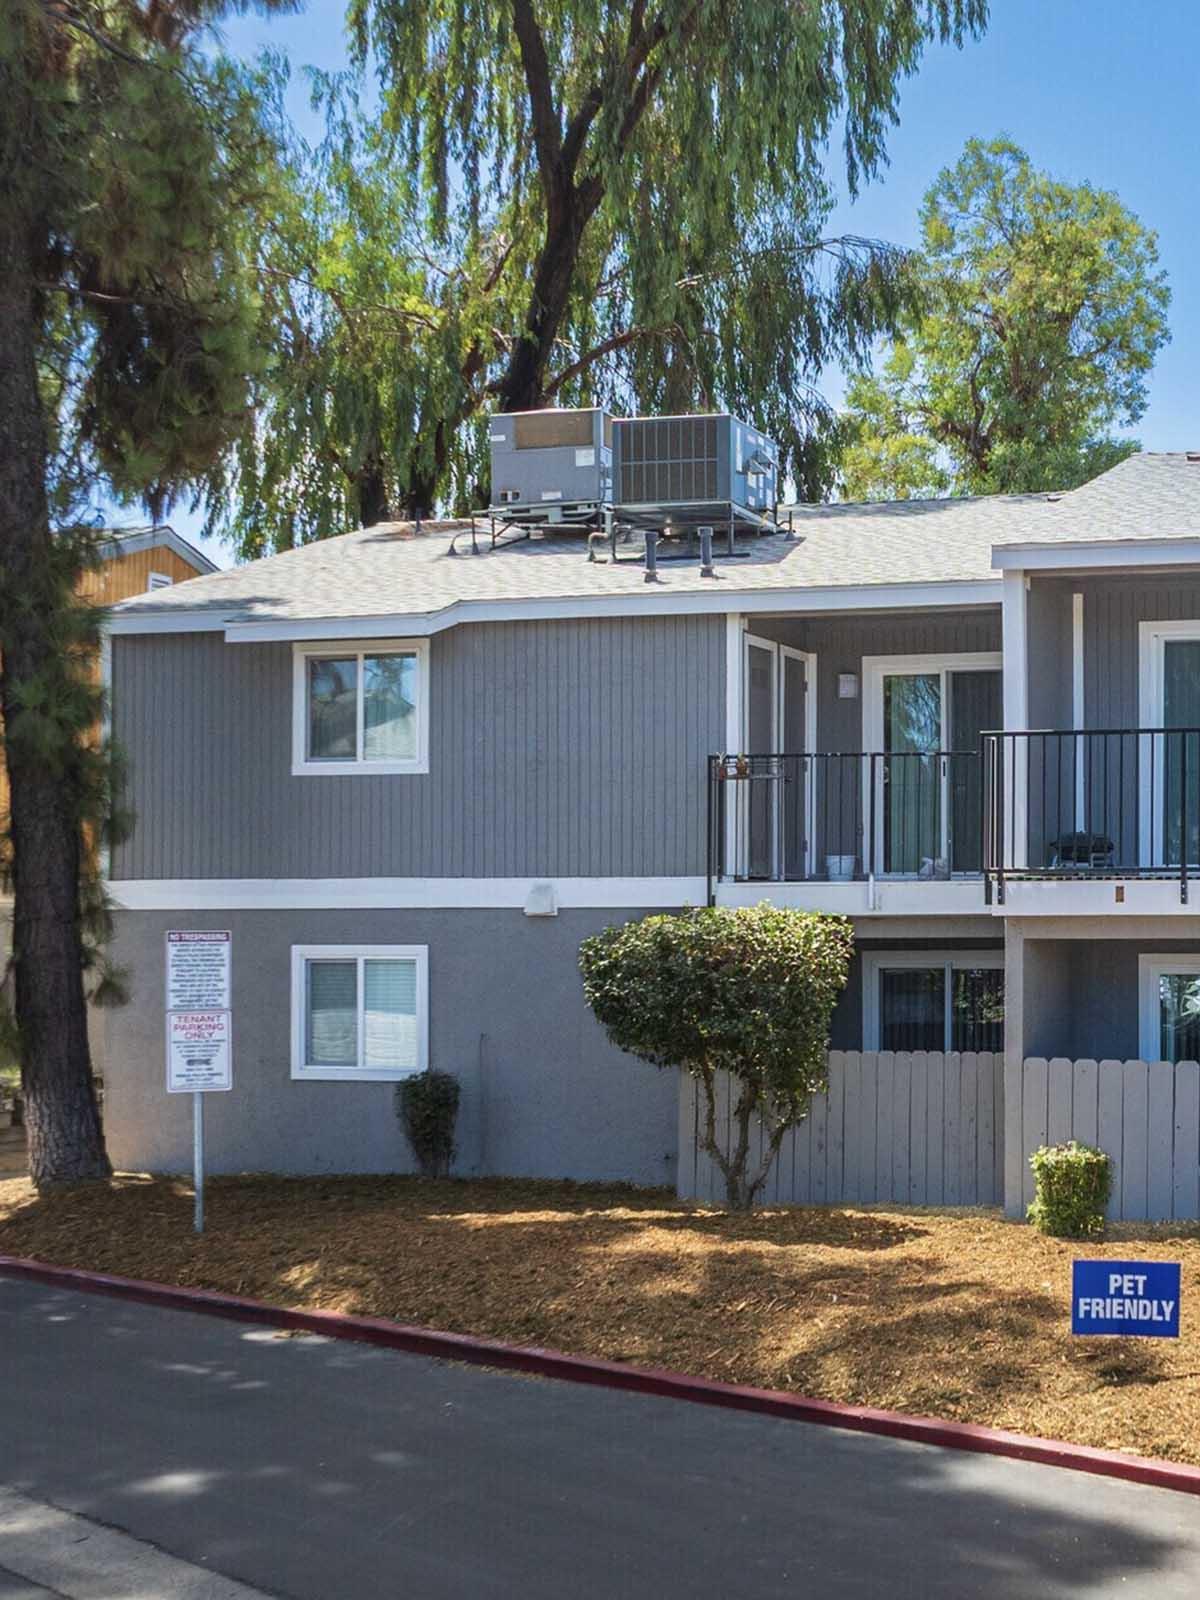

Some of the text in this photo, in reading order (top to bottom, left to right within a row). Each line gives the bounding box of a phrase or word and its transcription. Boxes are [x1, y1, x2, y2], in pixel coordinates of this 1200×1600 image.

[176, 1015, 222, 1023] TENANT
[174, 1023, 225, 1031] PARKING
[184, 1031, 216, 1040] ONLY
[1108, 1274, 1147, 1297] PET
[1078, 1297, 1175, 1323] FRIENDLY
